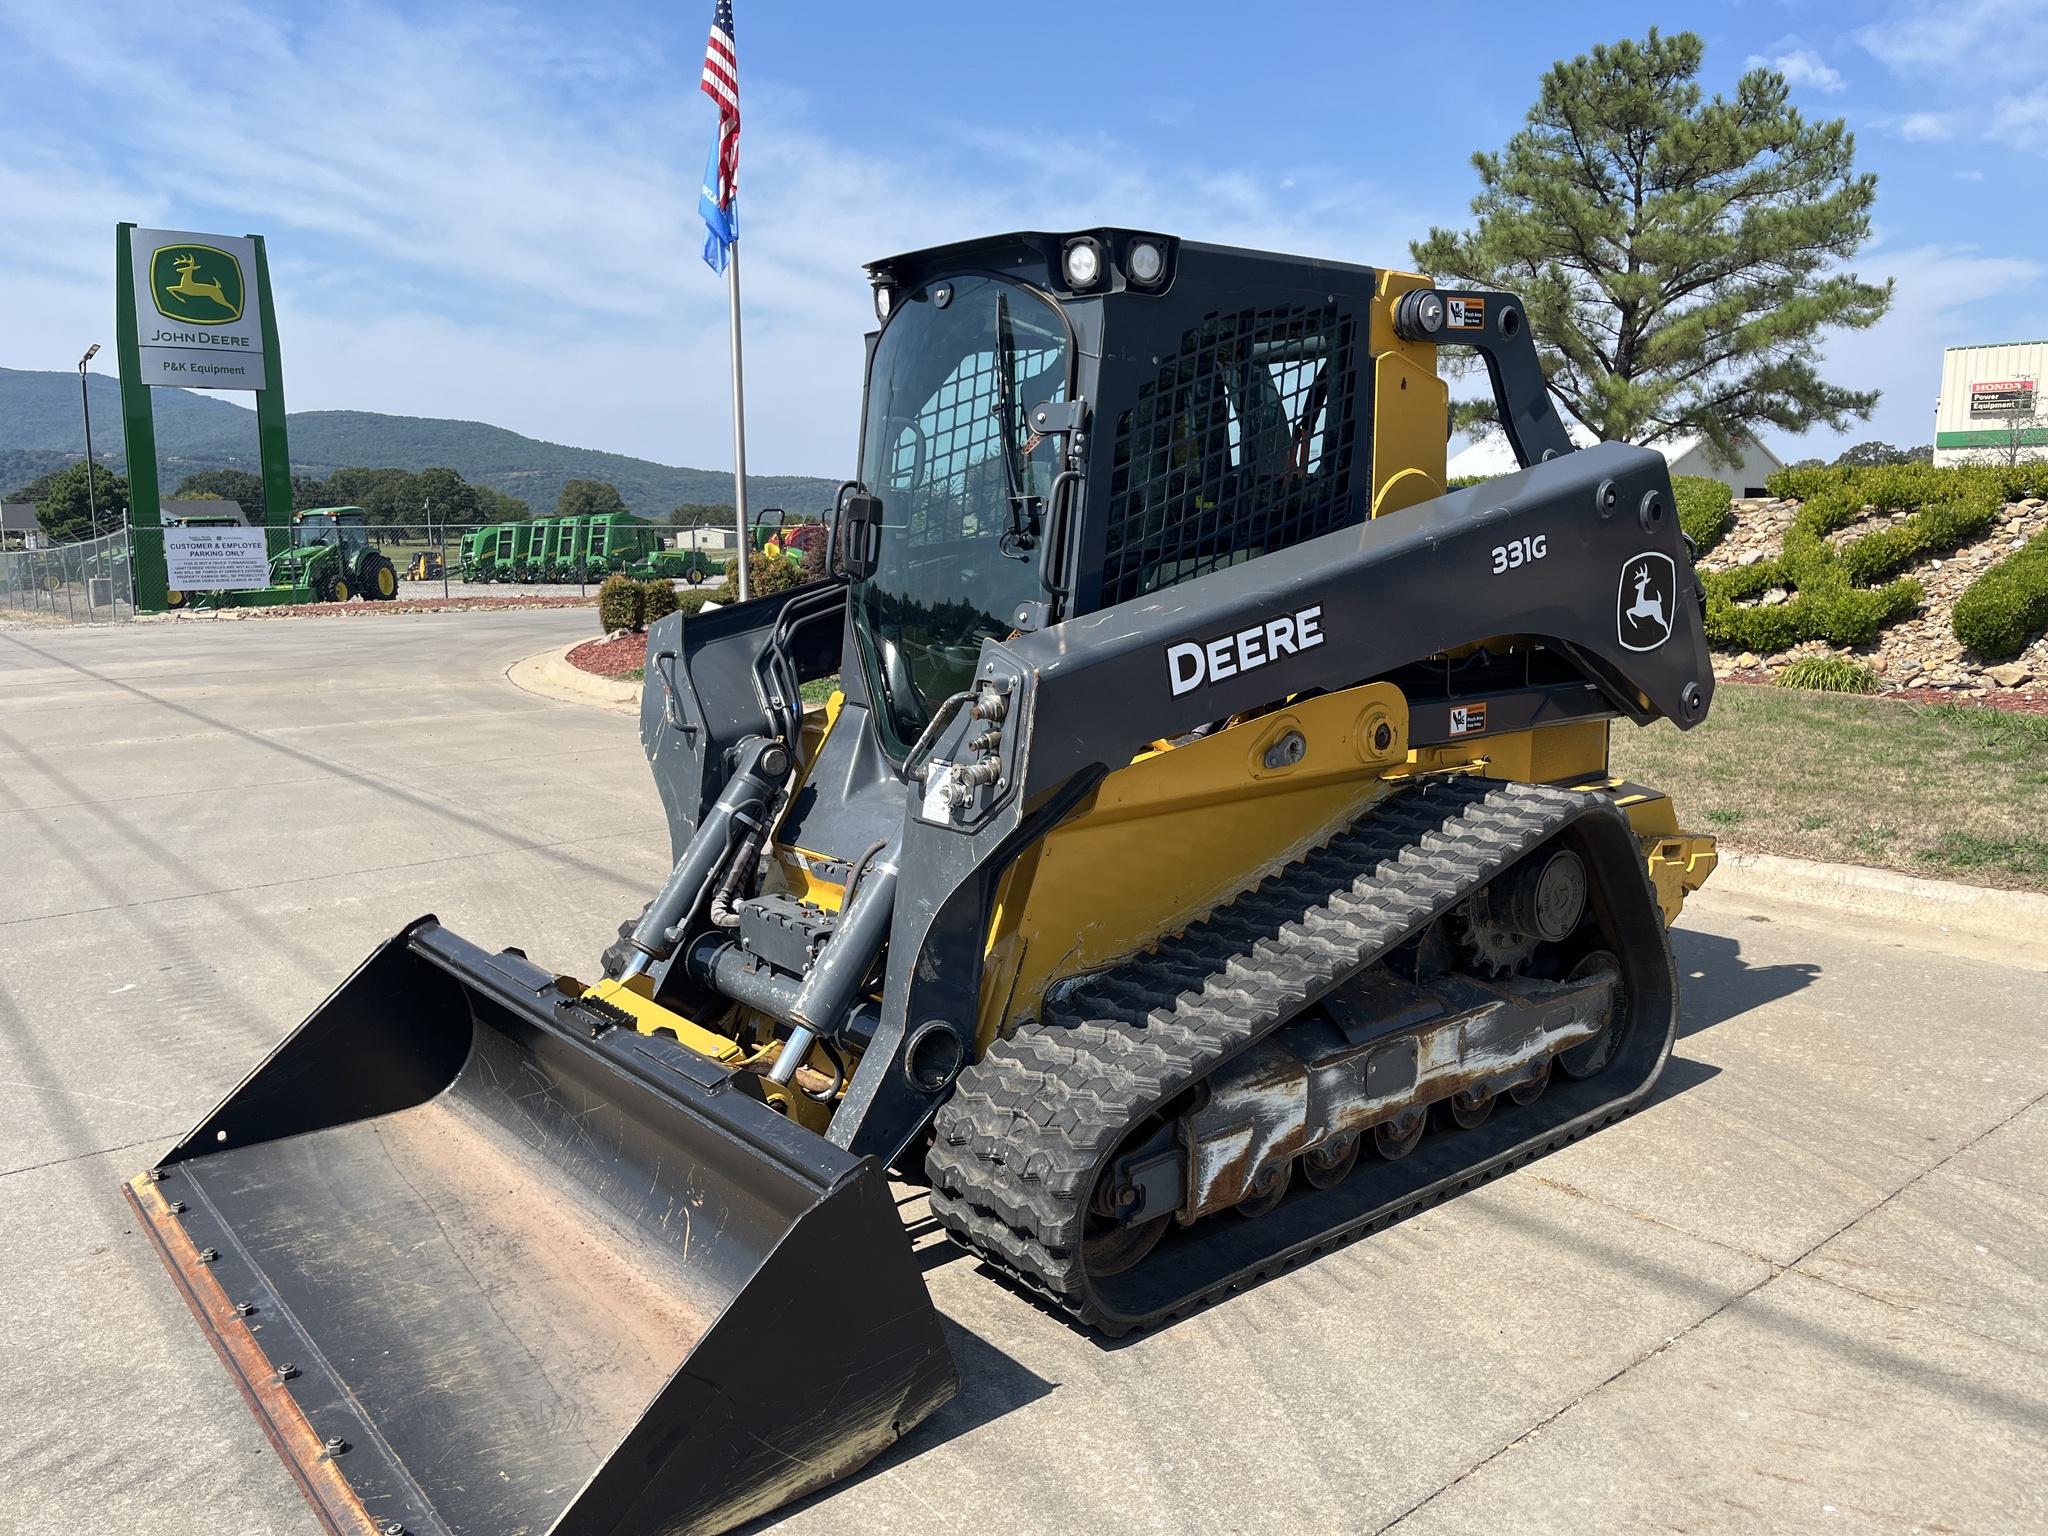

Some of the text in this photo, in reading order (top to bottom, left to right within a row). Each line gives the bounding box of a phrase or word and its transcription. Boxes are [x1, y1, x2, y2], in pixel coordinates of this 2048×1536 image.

[152, 330, 250, 346] JOHN DEERE
[163, 362, 246, 376] P&K Equipment
[1976, 382, 2021, 391] HONDA
[1492, 534, 1546, 574] 331G
[1167, 605, 1324, 696] DEERE
